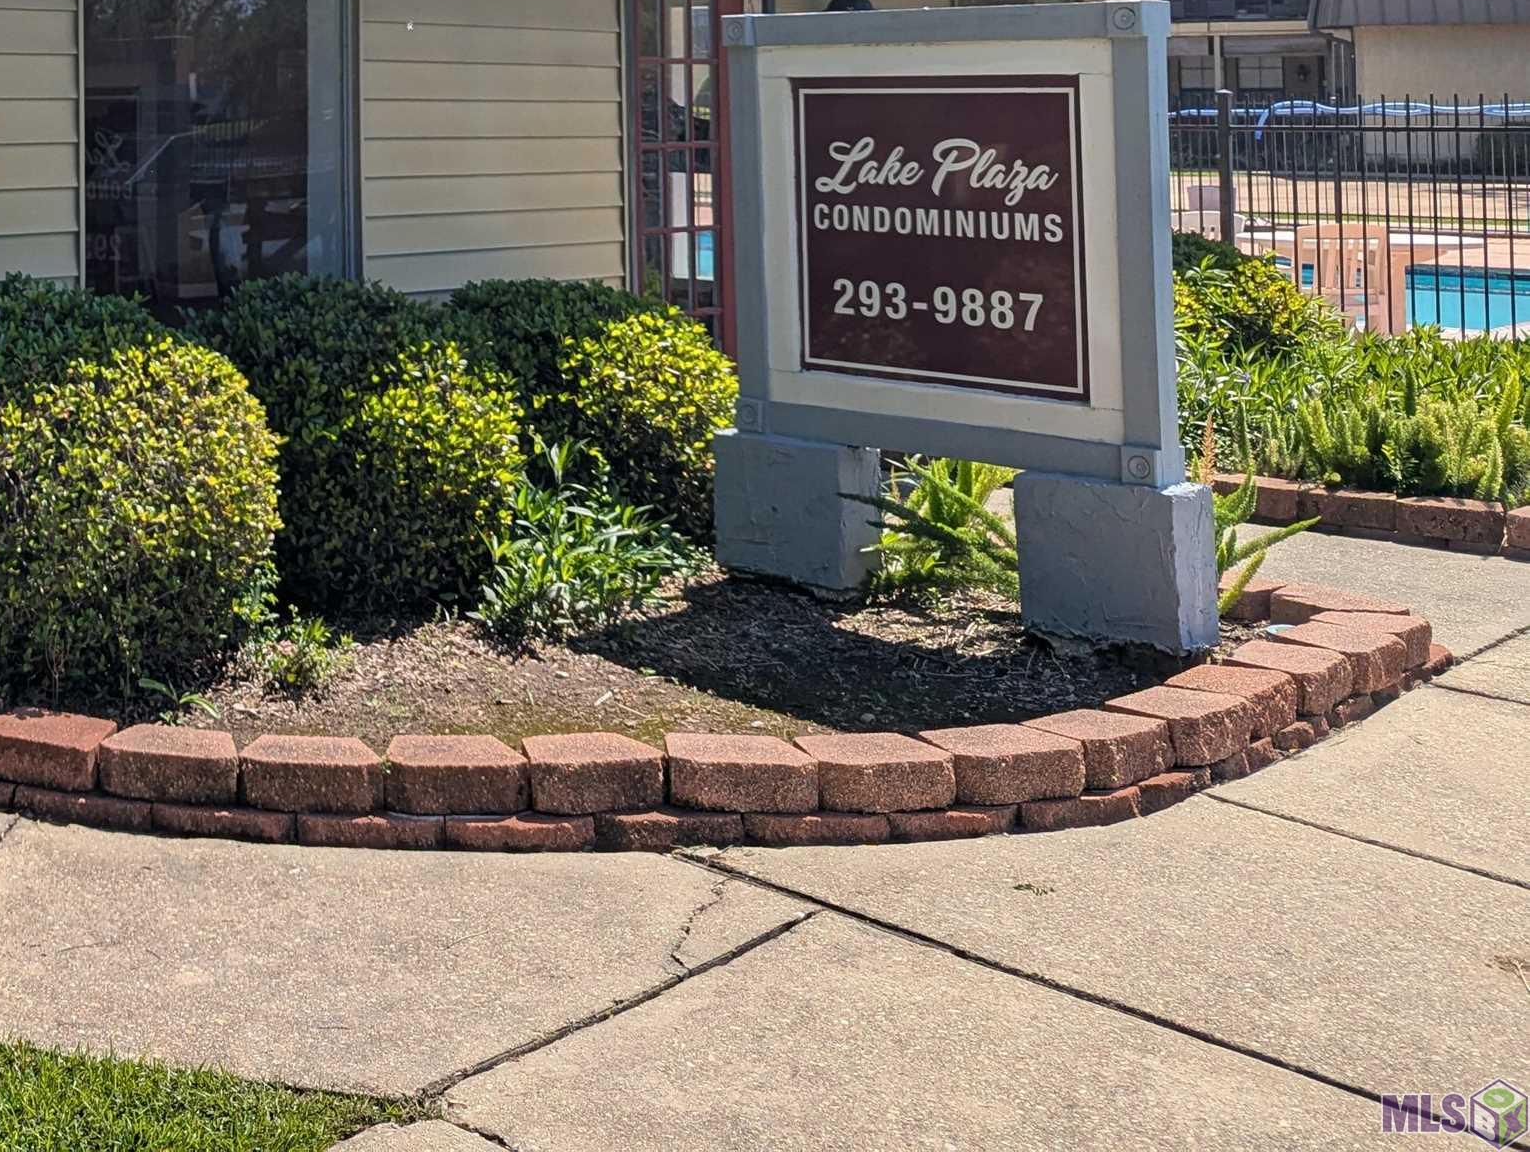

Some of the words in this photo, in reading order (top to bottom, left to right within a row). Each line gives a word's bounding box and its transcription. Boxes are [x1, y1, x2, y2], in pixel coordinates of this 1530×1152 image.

[814, 136, 924, 195] Lake
[931, 138, 1059, 206] Plaza
[813, 203, 1064, 243] CONDOMINIUMS
[833, 278, 1044, 332] 293-9887
